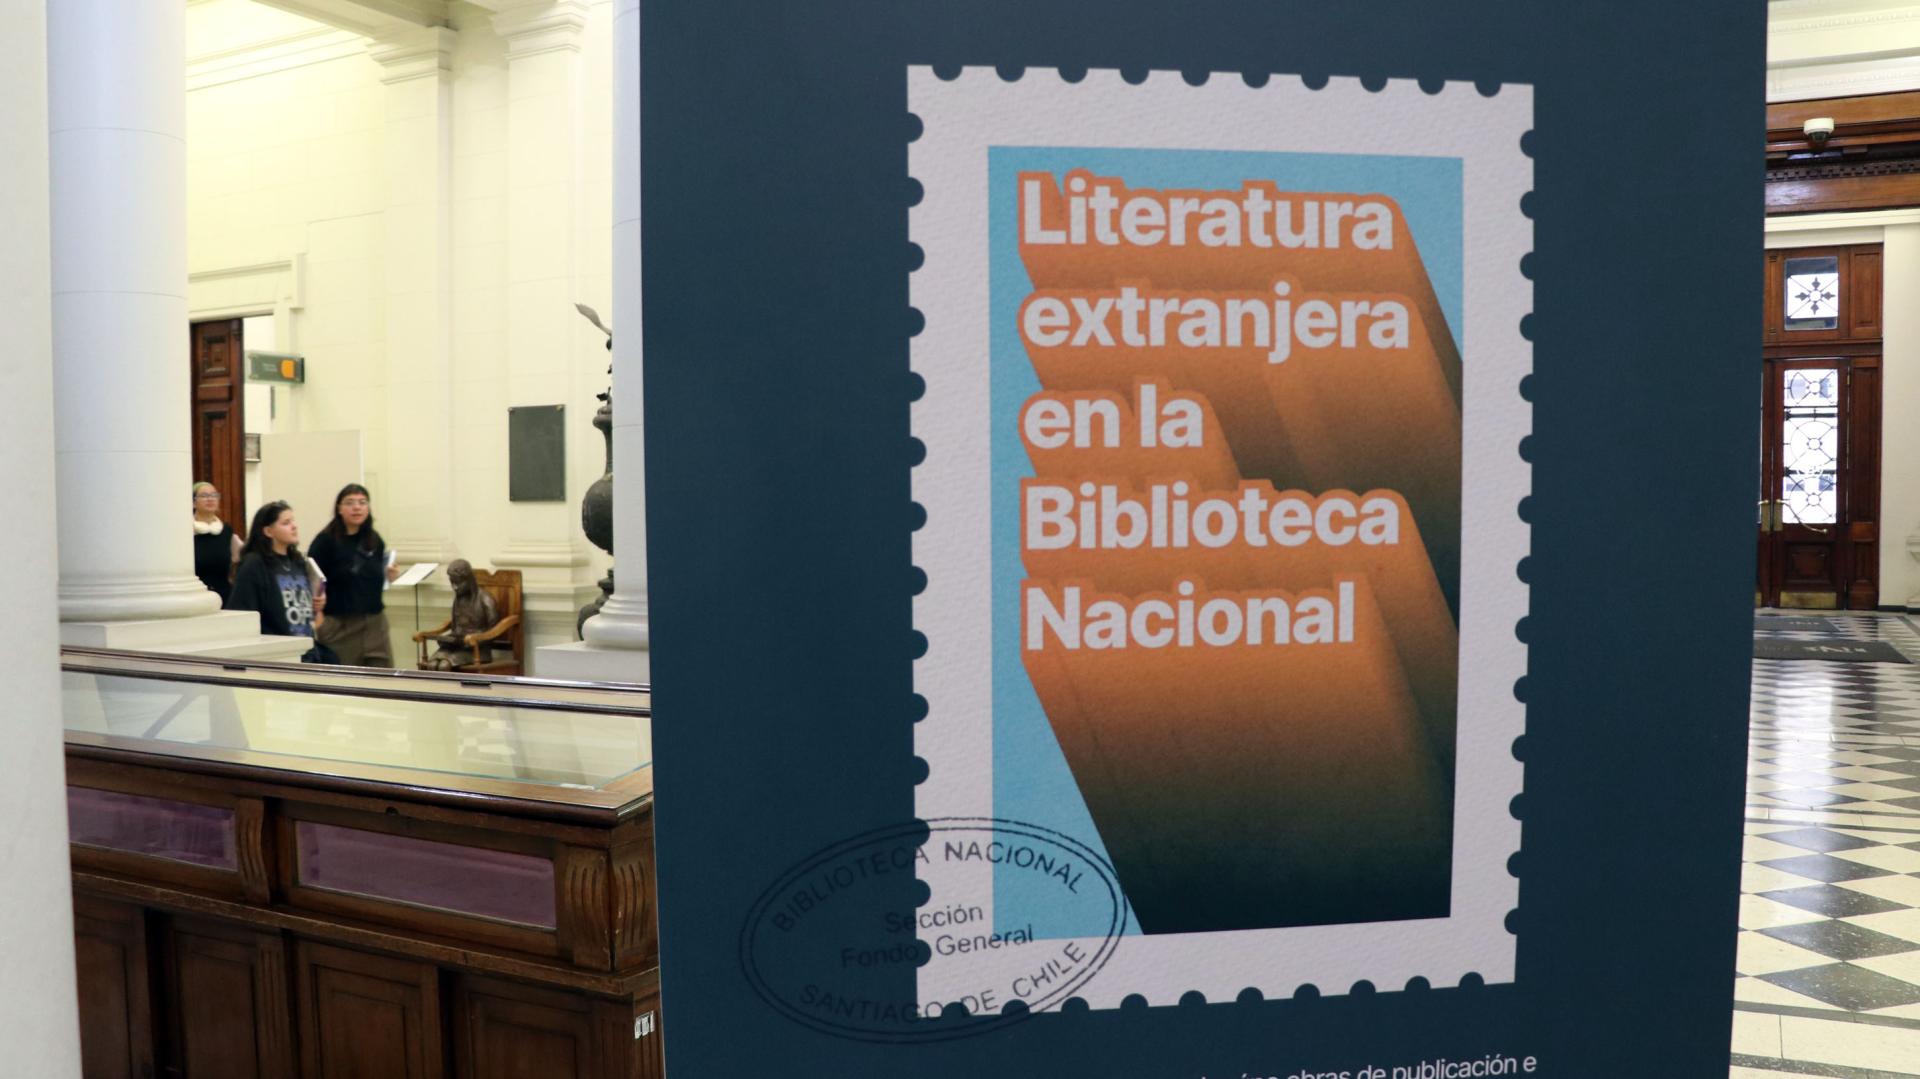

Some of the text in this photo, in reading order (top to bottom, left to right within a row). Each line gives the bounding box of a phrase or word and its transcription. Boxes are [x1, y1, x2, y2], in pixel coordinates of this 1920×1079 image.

[1023, 177, 1394, 250] Literatura
[1022, 281, 1410, 364] extranjera
[1024, 384, 1204, 450] en la
[1026, 480, 1400, 550] Biblioteca
[281, 589, 314, 609] PLA
[1026, 581, 1355, 650] Nacional
[772, 841, 1084, 933] BIBLIOTECA NACIONAL
[884, 903, 984, 934] Sección
[841, 924, 1034, 969] Fondo General
[800, 941, 1087, 1025] SANTIAGO DE CHILE
[1357, 1065, 1387, 1079] de
[1392, 1054, 1517, 1079] publicación
[1523, 1055, 1537, 1073] e
